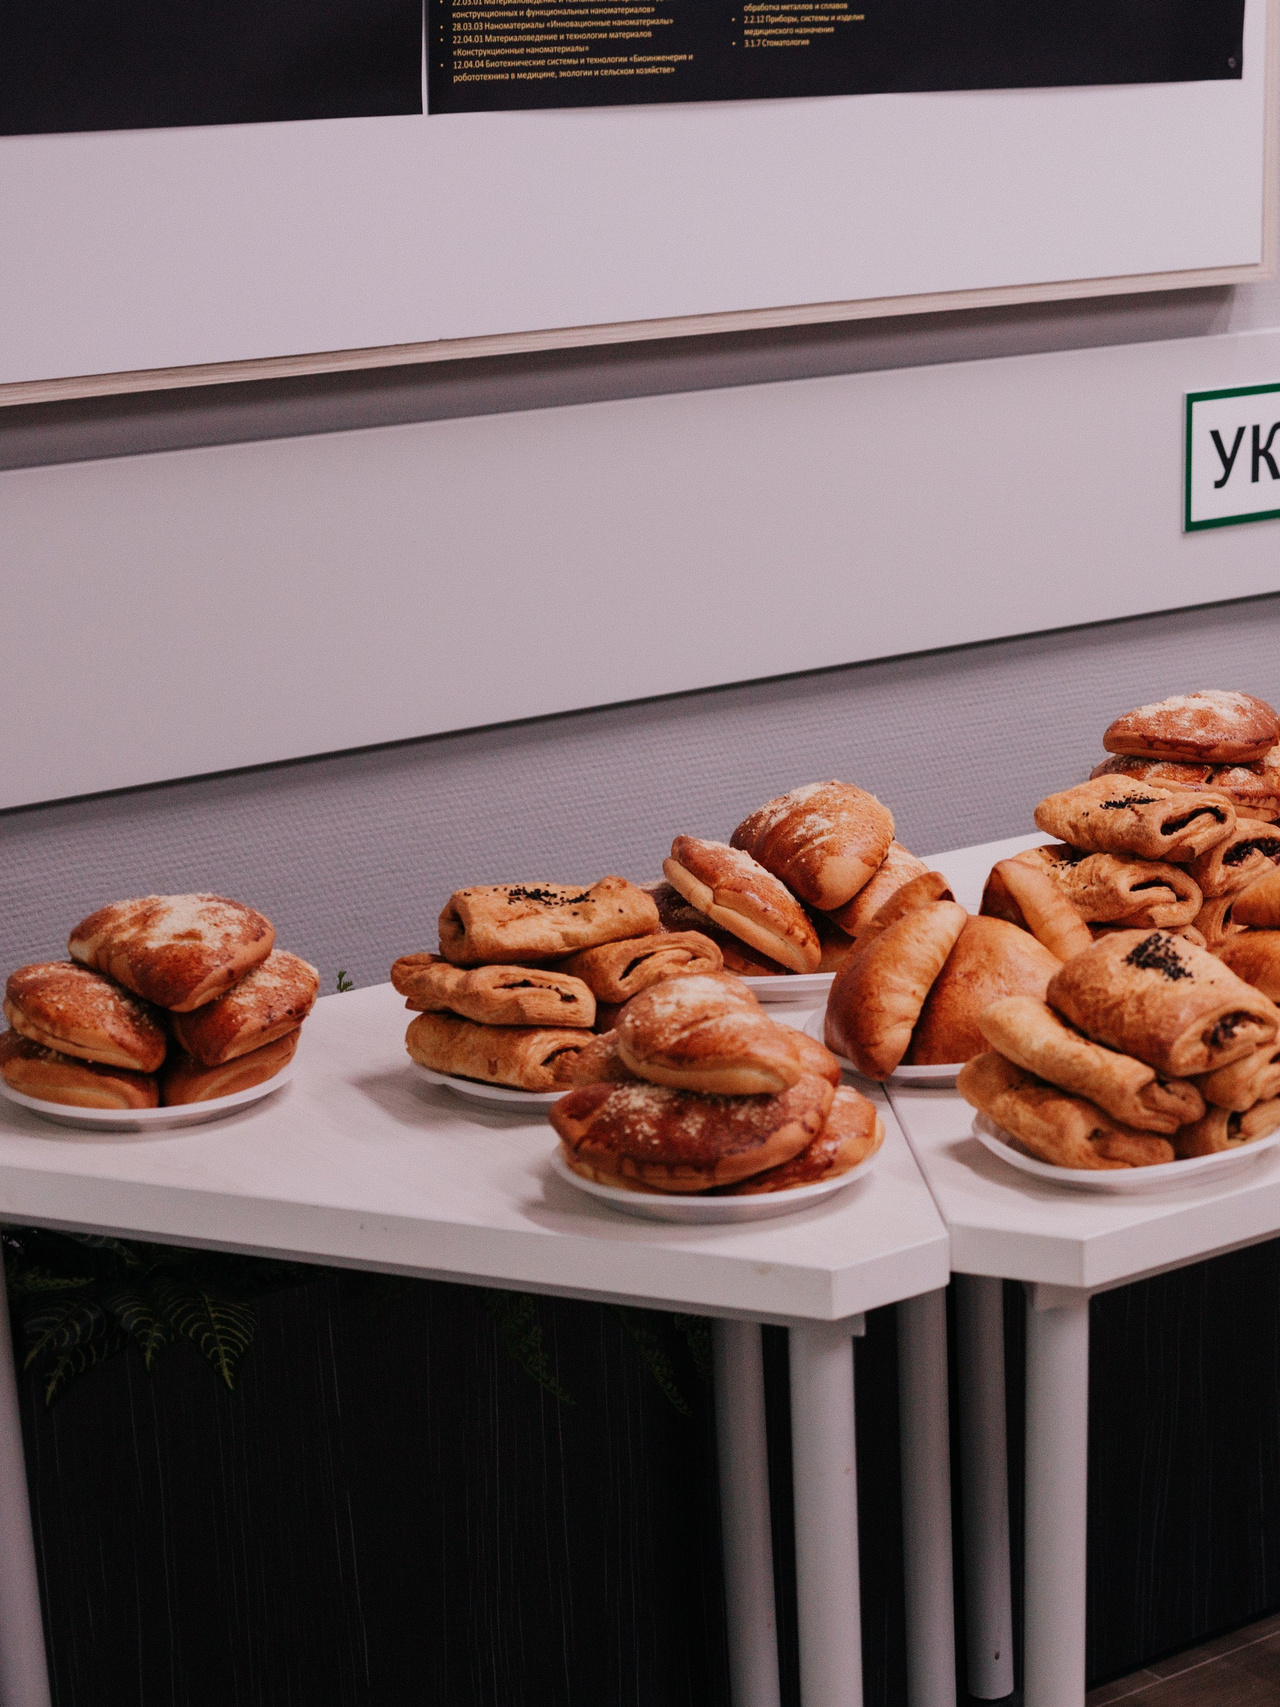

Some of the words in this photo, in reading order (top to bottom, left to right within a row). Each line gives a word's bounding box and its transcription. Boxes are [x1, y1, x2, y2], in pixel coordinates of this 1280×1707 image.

[452, 10, 518, 20] конструкционных
[525, 8, 589, 18] функциональных
[590, 6, 655, 15] наноматериалов»
[452, 22, 484, 32] 28.03.03
[484, 22, 545, 30] Наноматериалы
[546, 20, 611, 28] «Инновационные
[612, 18, 674, 27] наноматериалы»
[452, 34, 484, 44] 22.04.01
[484, 34, 558, 44] Материаловедение
[566, 32, 608, 40] технологии
[608, 31, 652, 40] материалов
[452, 47, 525, 58] «Конструкционные
[525, 45, 590, 54] наноматериалы»
[454, 60, 484, 70] 12.04.04
[485, 59, 546, 68] Биотехнические
[546, 58, 579, 66] системы
[586, 56, 628, 64] технологии
[629, 54, 687, 63] «Биоинженерия
[453, 72, 510, 84] робототехника
[516, 71, 558, 80] медицине,
[559, 70, 593, 78] экологии
[600, 68, 635, 76] сельском
[635, 66, 675, 75] хозяйстве»
